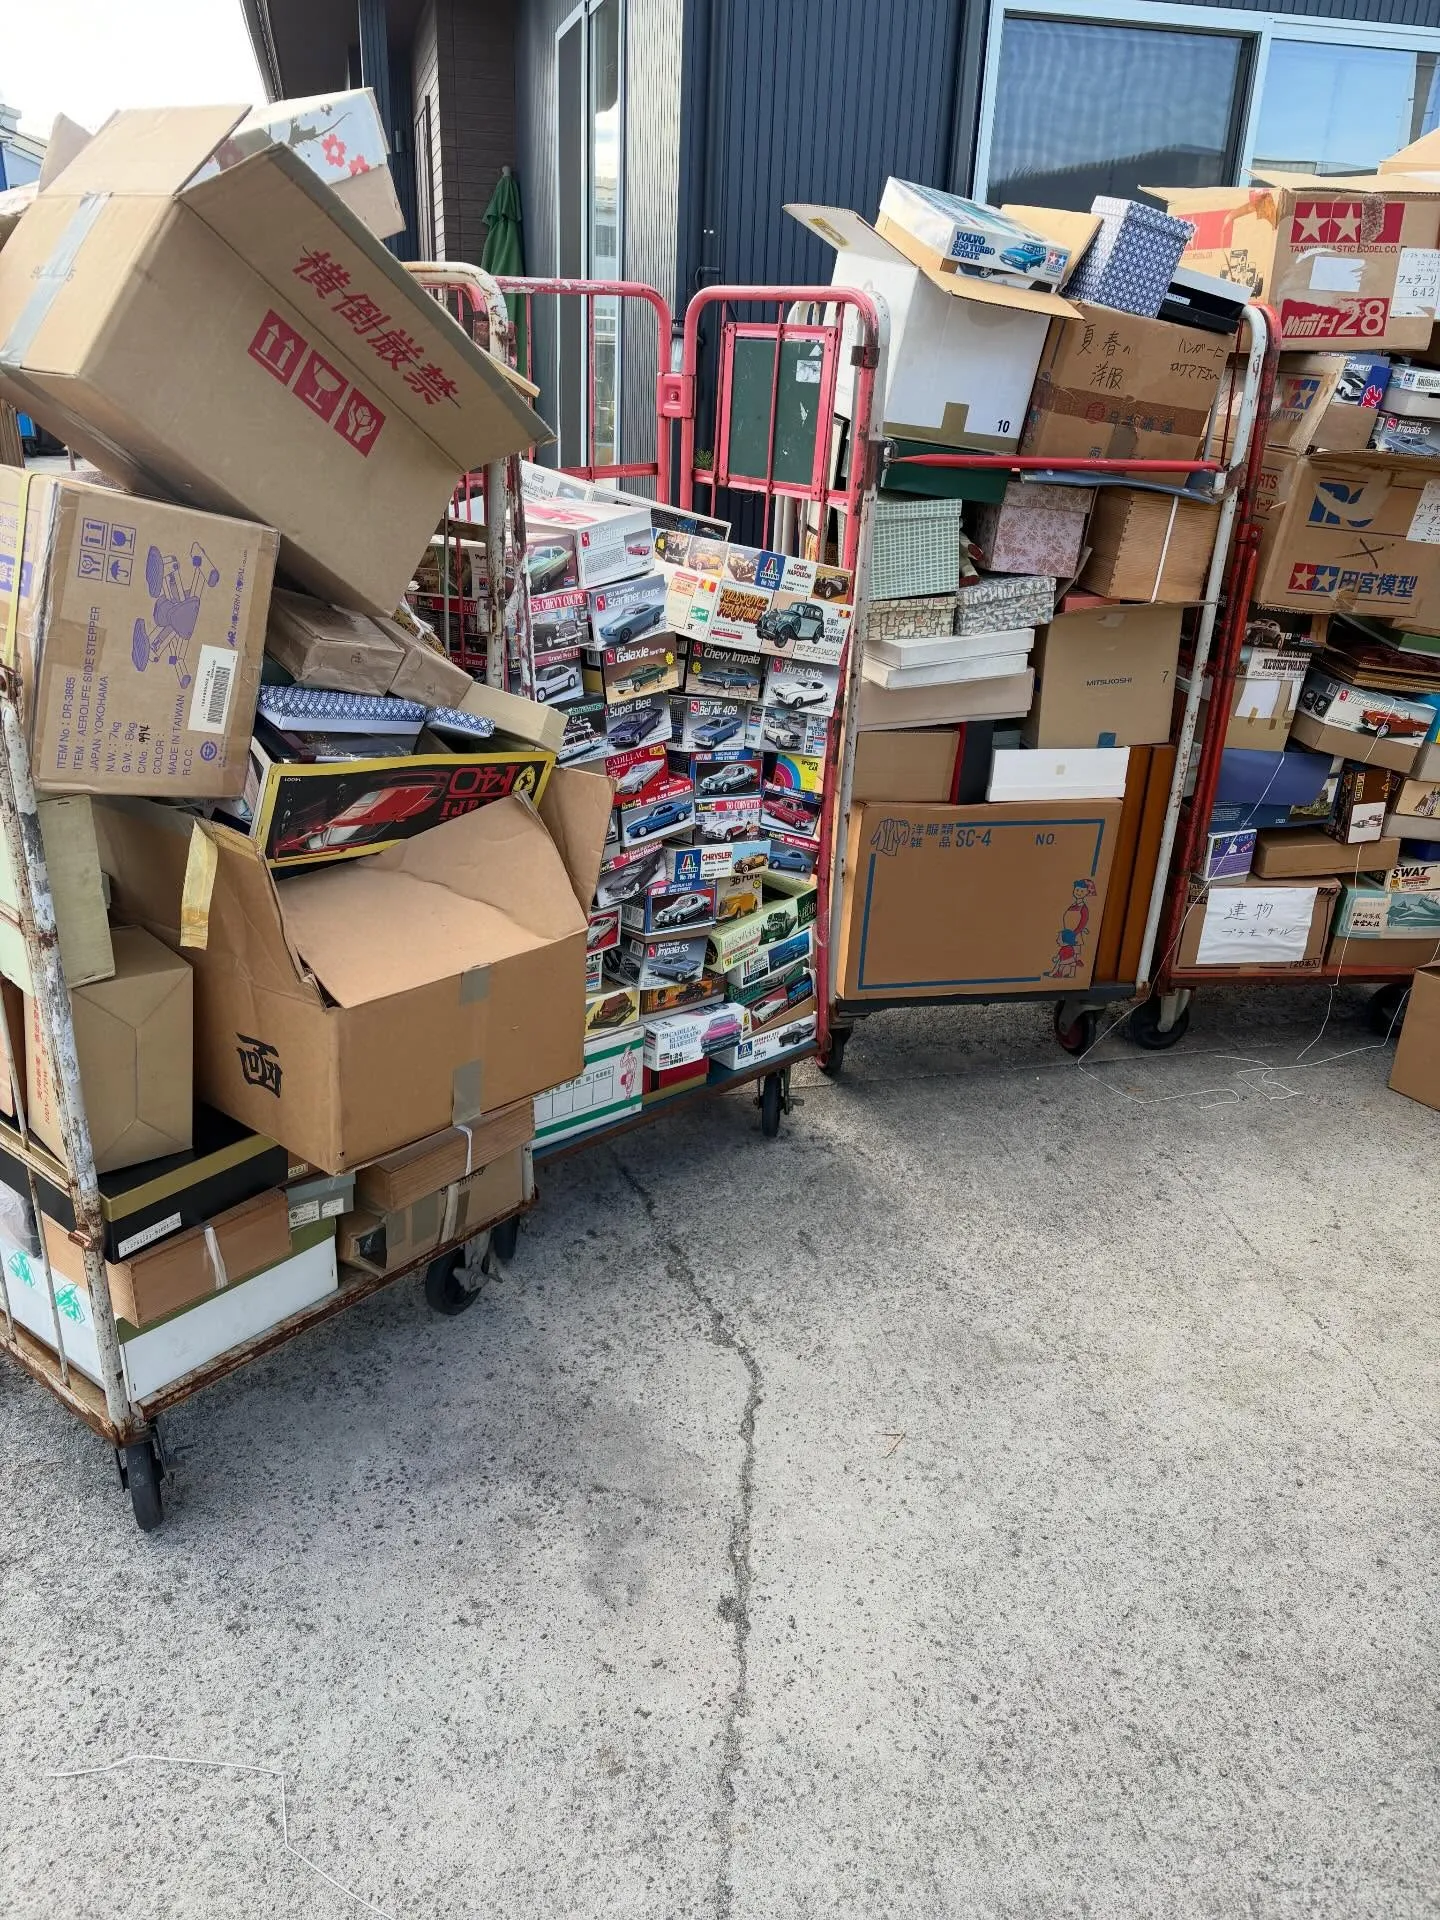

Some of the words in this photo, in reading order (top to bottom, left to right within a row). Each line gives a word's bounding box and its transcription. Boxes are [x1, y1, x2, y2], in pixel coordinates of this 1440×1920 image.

[956, 231, 985, 245] VOLVO
[951, 248, 980, 260] ESTATE
[953, 241, 968, 251] 850
[970, 244, 995, 256] TURBO
[1290, 245, 1319, 253] TAM
[1399, 273, 1437, 285] フェラーリ
[1412, 287, 1435, 297] 642
[1336, 300, 1385, 335] 28
[293, 248, 460, 407] 横倒厳禁
[1090, 361, 1123, 390] 洋服
[996, 419, 1011, 434] 10
[234, 566, 245, 593] ROYAL
[1338, 571, 1418, 598] 田宮模型
[541, 596, 563, 611] CHEVY
[563, 592, 584, 607] COUPE
[607, 593, 640, 608] Starliner
[230, 593, 242, 630] MODERN
[85, 606, 100, 656] STEPPER
[616, 647, 649, 663] Galaxie
[704, 648, 730, 662] Chevy
[731, 651, 760, 665] Impala
[82, 658, 95, 683] SIDE
[783, 665, 806, 676] Hurst
[807, 667, 823, 679] Olds
[1162, 670, 1169, 684] 7
[1086, 677, 1132, 686] MITSUKOSHI
[77, 685, 91, 737] AEROLIFE
[94, 675, 108, 734] YOKOHAMA
[171, 694, 185, 734] TAIWAN
[609, 704, 635, 718] Super
[635, 698, 652, 711] Bee
[700, 705, 711, 715] Bel
[711, 705, 723, 715] Air
[722, 705, 738, 716] 409
[58, 728, 70, 742] No
[108, 721, 121, 741] 7kg
[124, 722, 137, 741] 8kg
[170, 734, 180, 746] IN
[56, 744, 69, 770] ITEM
[73, 745, 86, 771] ITEM
[91, 738, 103, 772] JAPAN
[106, 750, 118, 772] N.W.
[122, 750, 132, 773] G.W.
[152, 740, 164, 775] COLOR
[168, 748, 180, 775] MADE
[183, 747, 193, 776] R.O.C.
[606, 749, 645, 767] CADILLAC
[450, 765, 520, 797] F40
[911, 824, 954, 835] 洋服類
[956, 829, 992, 848] SC-4
[1035, 833, 1057, 846] NO.
[702, 851, 732, 861] CHRYSLER
[1392, 866, 1433, 878] SWAT
[1224, 901, 1274, 921] 建物
[657, 945, 680, 957] Impala
[679, 943, 689, 953] SS
[668, 1024, 698, 1039] CADILLAC
[669, 1030, 701, 1044] ELDORADO
